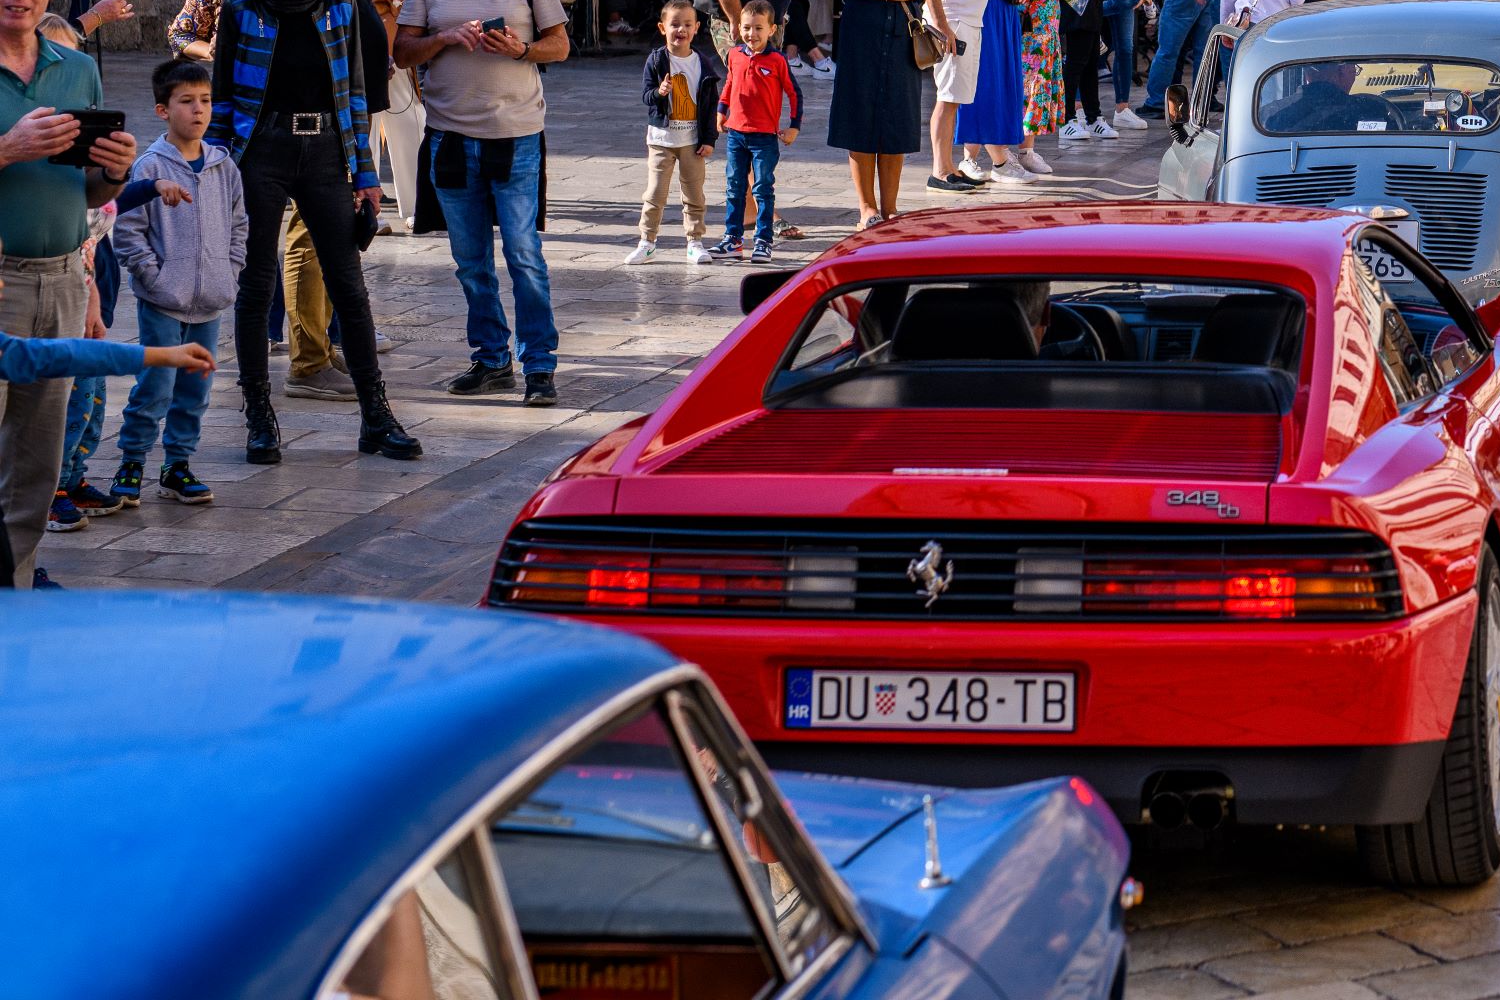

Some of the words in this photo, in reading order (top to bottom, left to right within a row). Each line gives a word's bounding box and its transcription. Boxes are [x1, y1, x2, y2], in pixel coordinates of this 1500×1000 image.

[1461, 118, 1483, 126] BIH
[1167, 489, 1220, 505] 348
[1217, 502, 1240, 518] tb
[818, 676, 870, 721] DU
[906, 677, 1067, 723] 348-TB
[788, 705, 810, 719] HR
